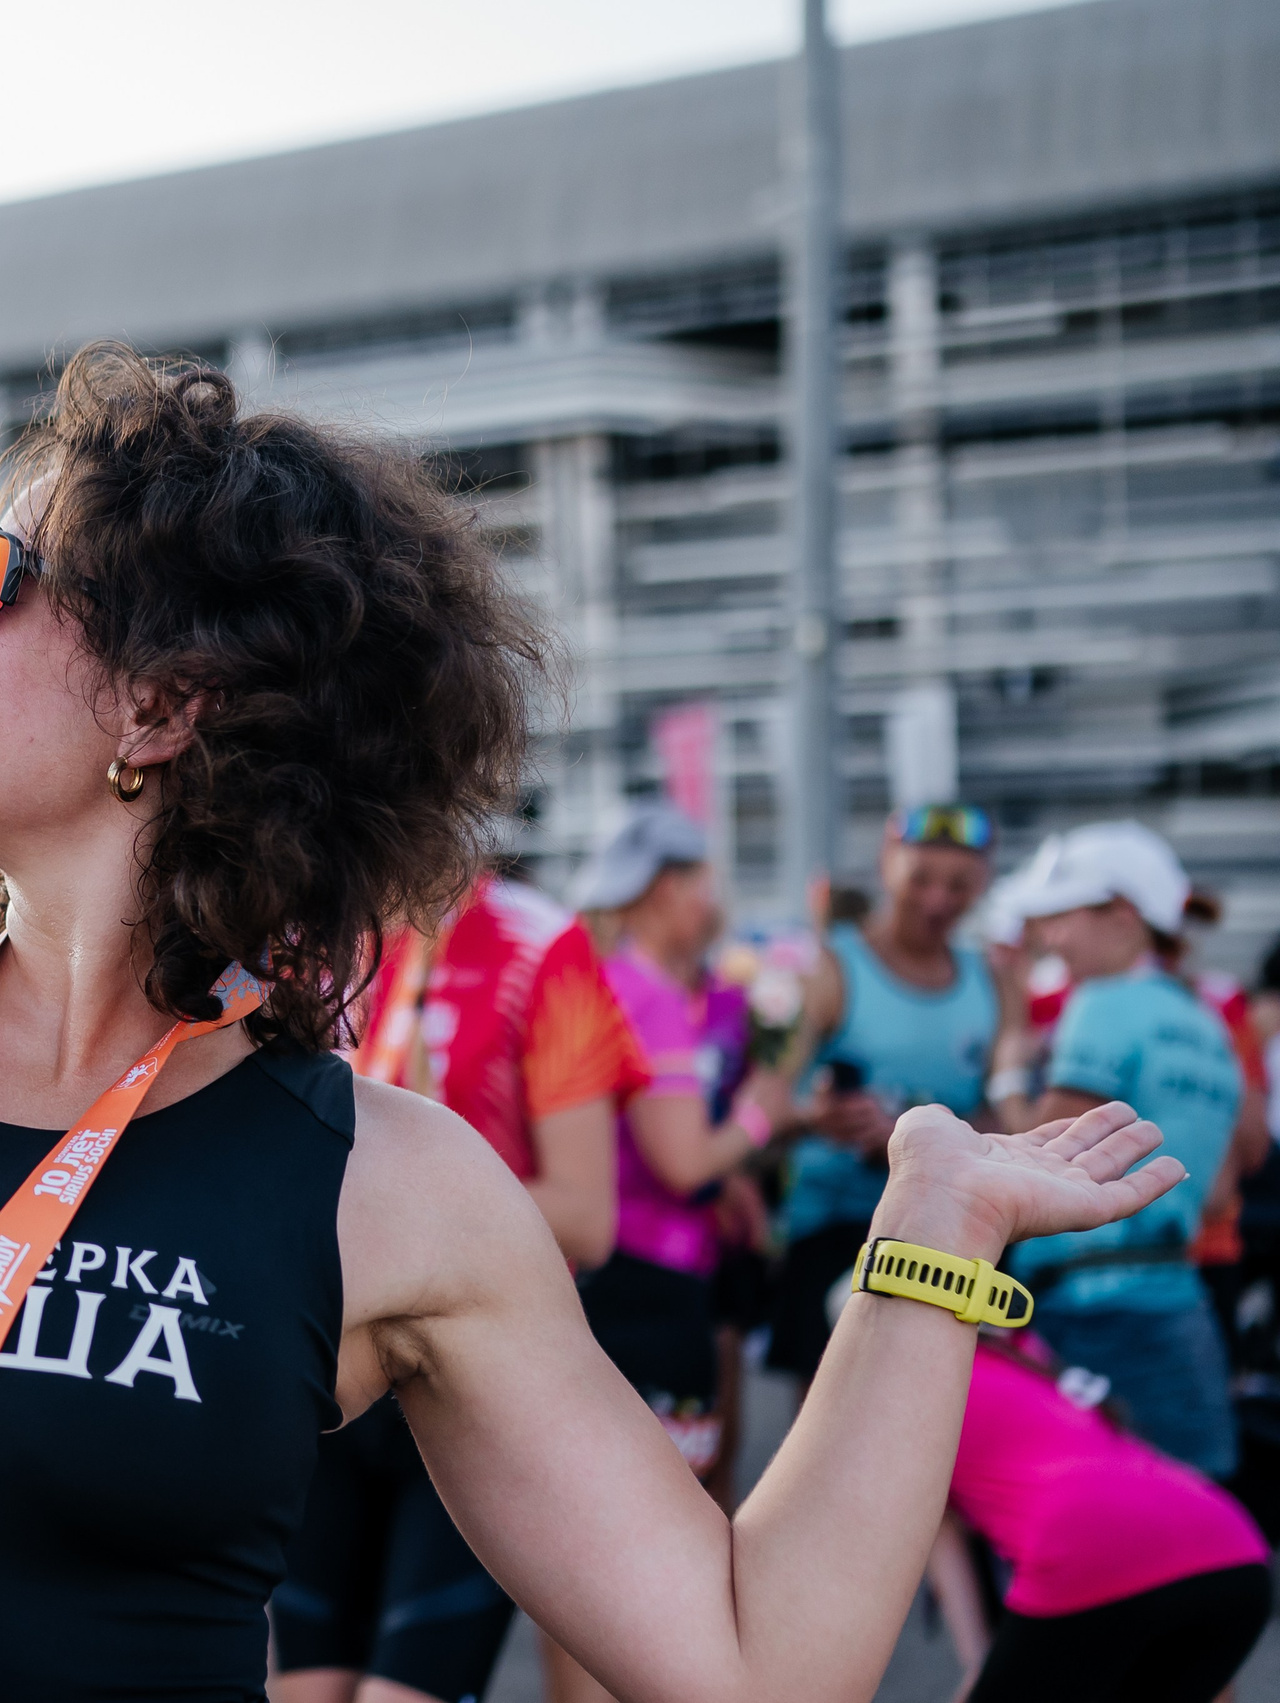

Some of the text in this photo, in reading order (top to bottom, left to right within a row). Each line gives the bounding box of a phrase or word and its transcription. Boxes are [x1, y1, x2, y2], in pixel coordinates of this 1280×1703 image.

[34, 1169, 71, 1196] 10
[59, 1128, 117, 1205] SIRIUS SOCHI
[128, 1303, 246, 1340] DMIX
